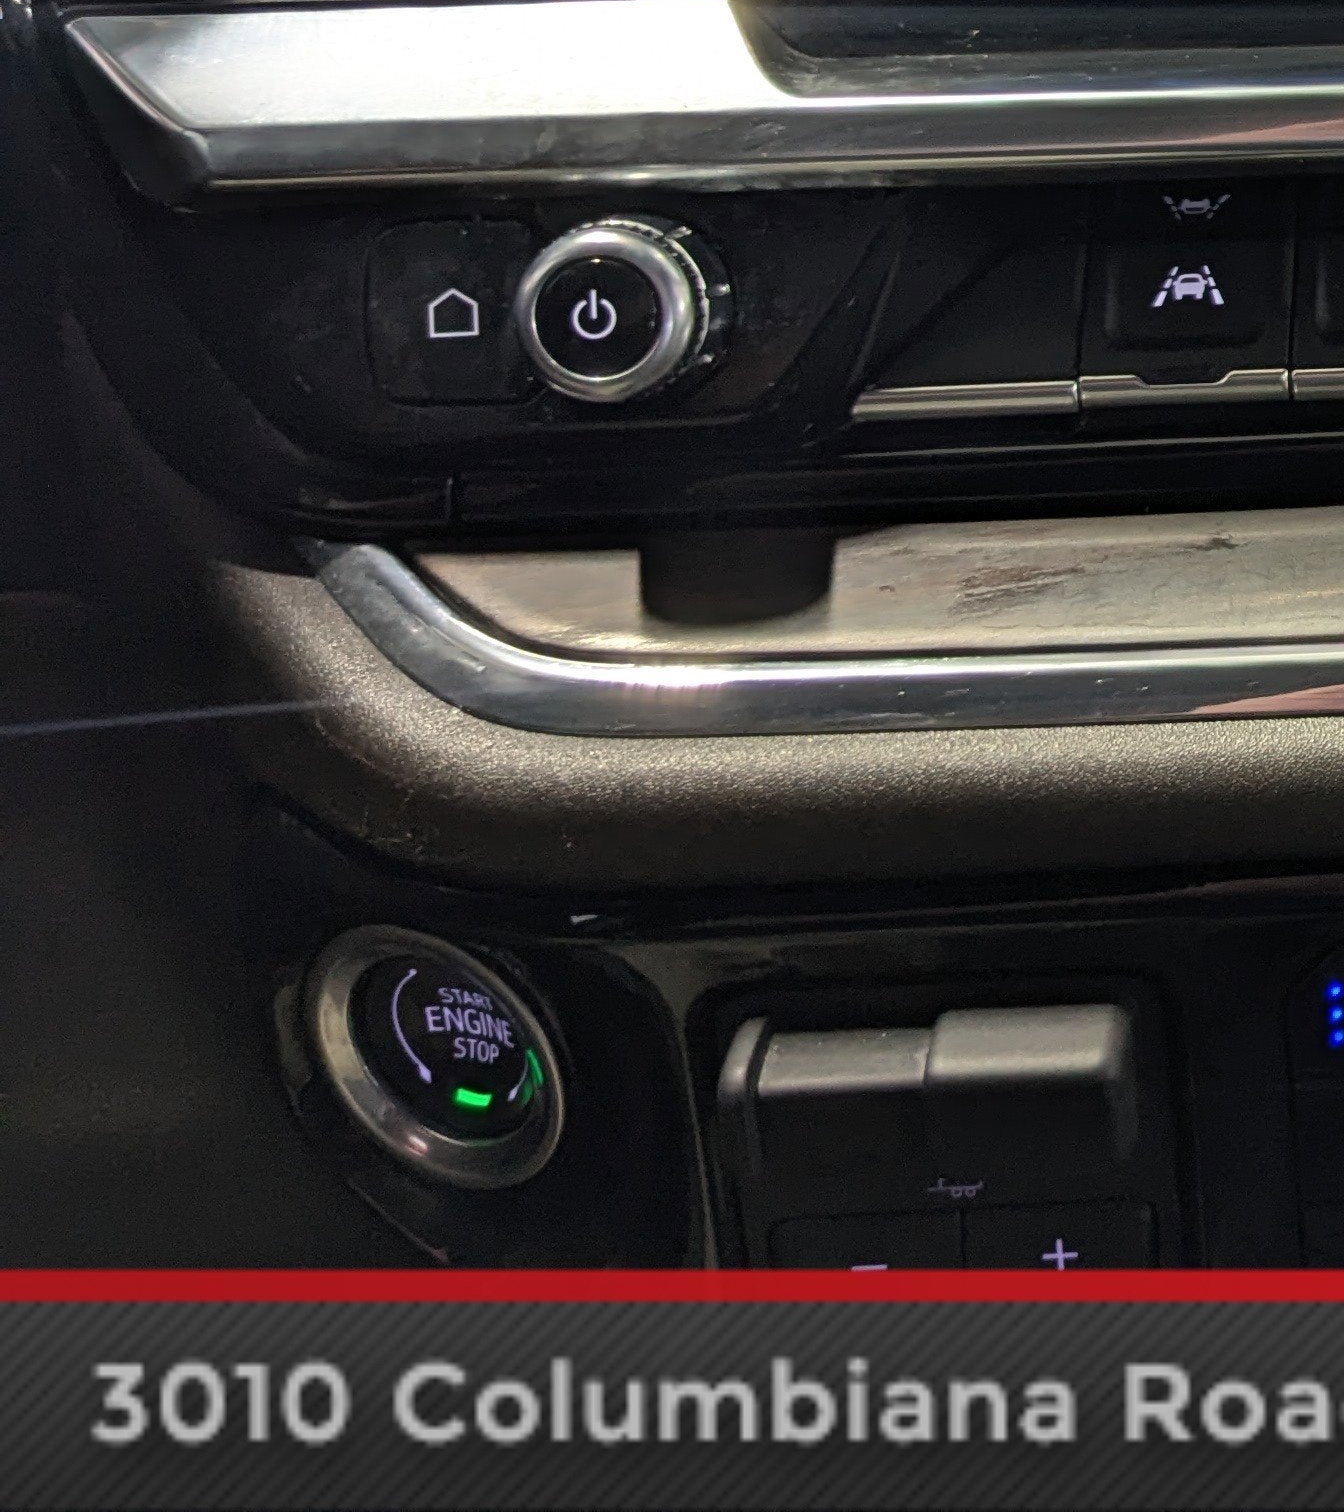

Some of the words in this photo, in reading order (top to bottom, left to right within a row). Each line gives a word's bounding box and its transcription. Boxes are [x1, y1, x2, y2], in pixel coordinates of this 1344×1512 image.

[438, 987, 493, 1010] START
[424, 1006, 514, 1048] ENGINE
[452, 1037, 499, 1065] STOP
